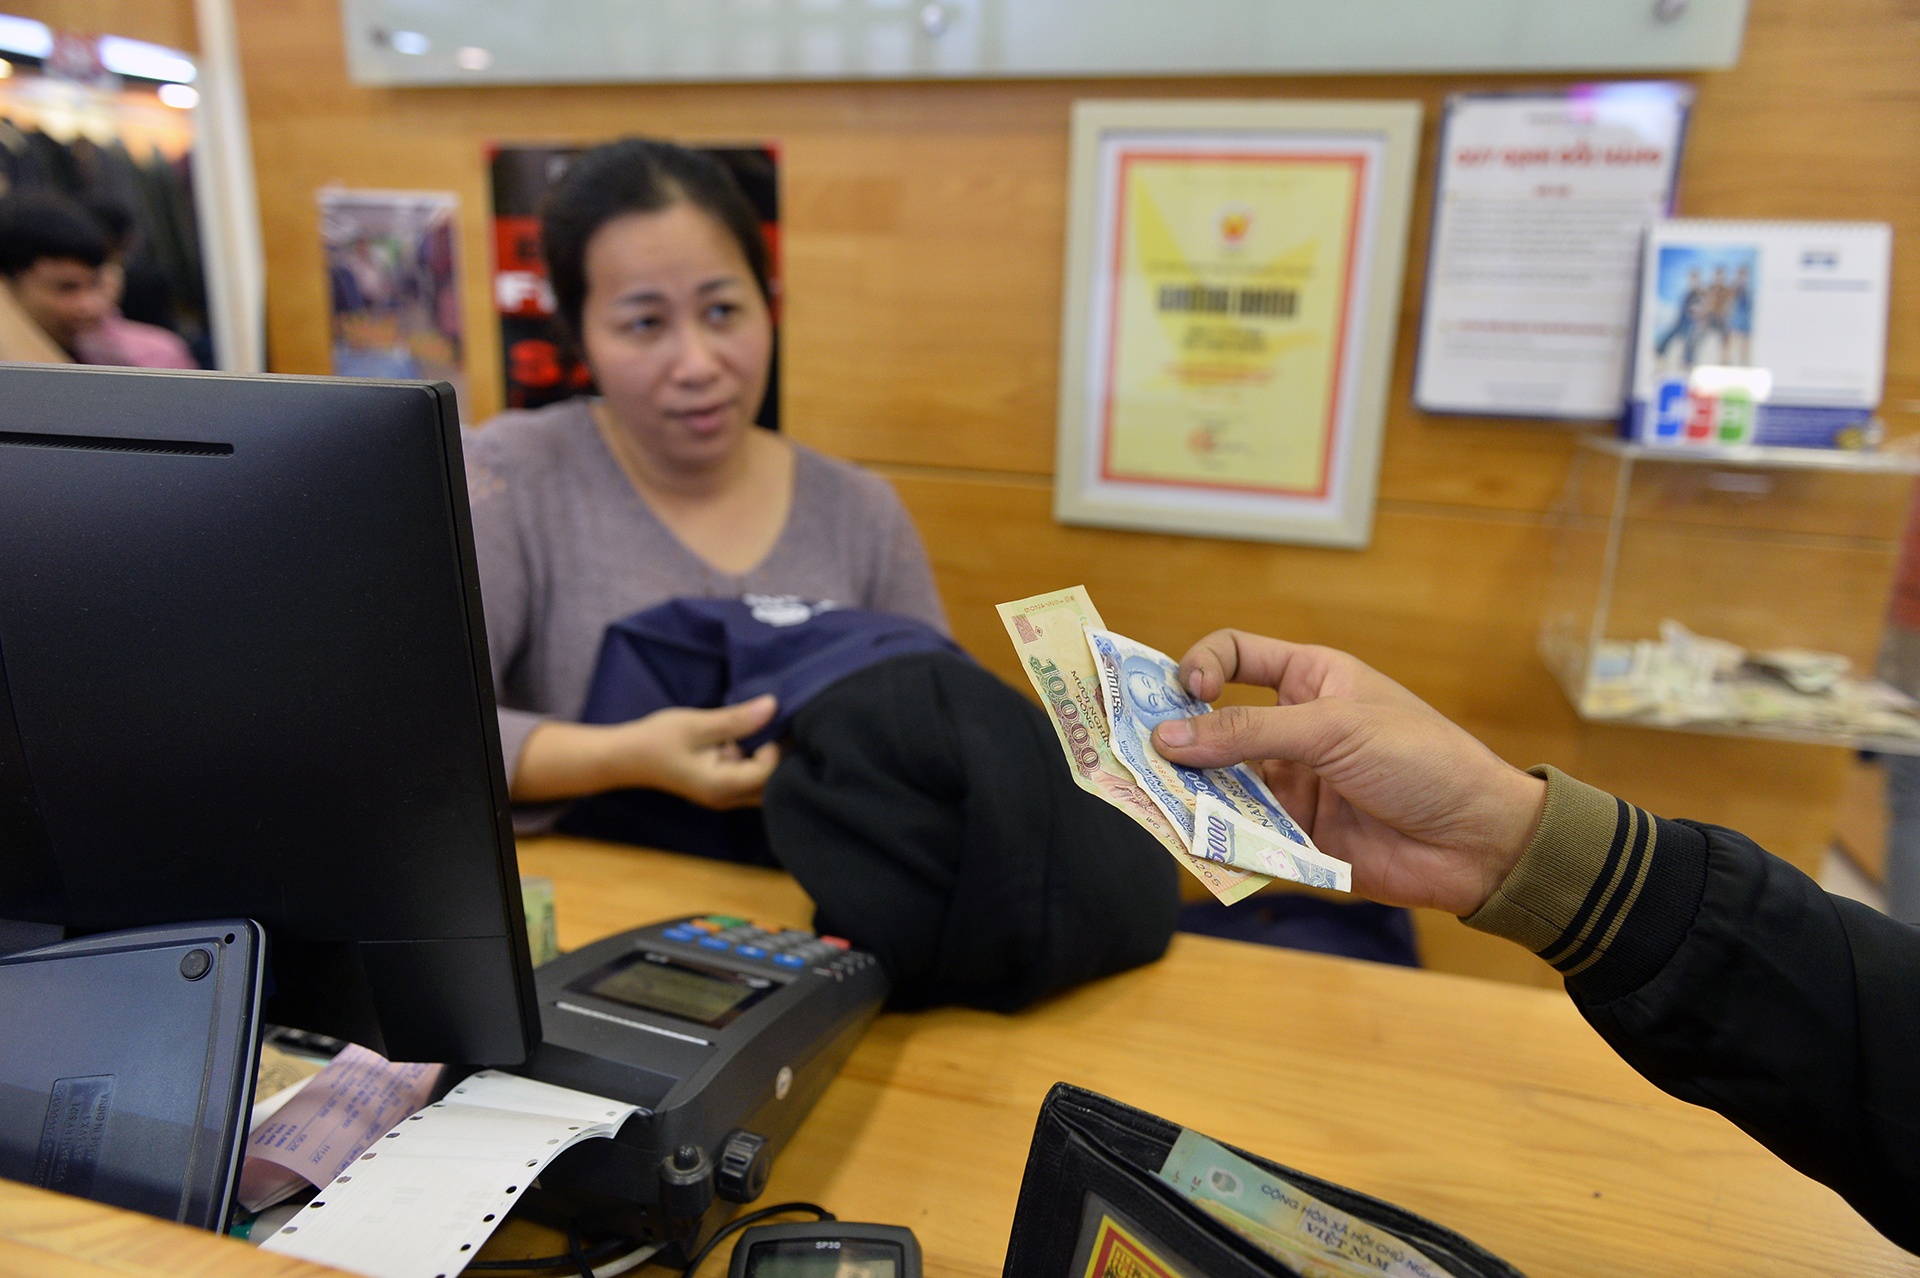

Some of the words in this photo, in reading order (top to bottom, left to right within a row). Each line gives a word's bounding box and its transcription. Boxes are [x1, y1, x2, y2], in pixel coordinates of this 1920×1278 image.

[1040, 658, 1100, 771] 10000
[1213, 770, 1246, 801] NGH
[1205, 815, 1228, 864] 5000
[96, 1093, 110, 1121] CHINA
[1351, 1246, 1390, 1271] NAM
